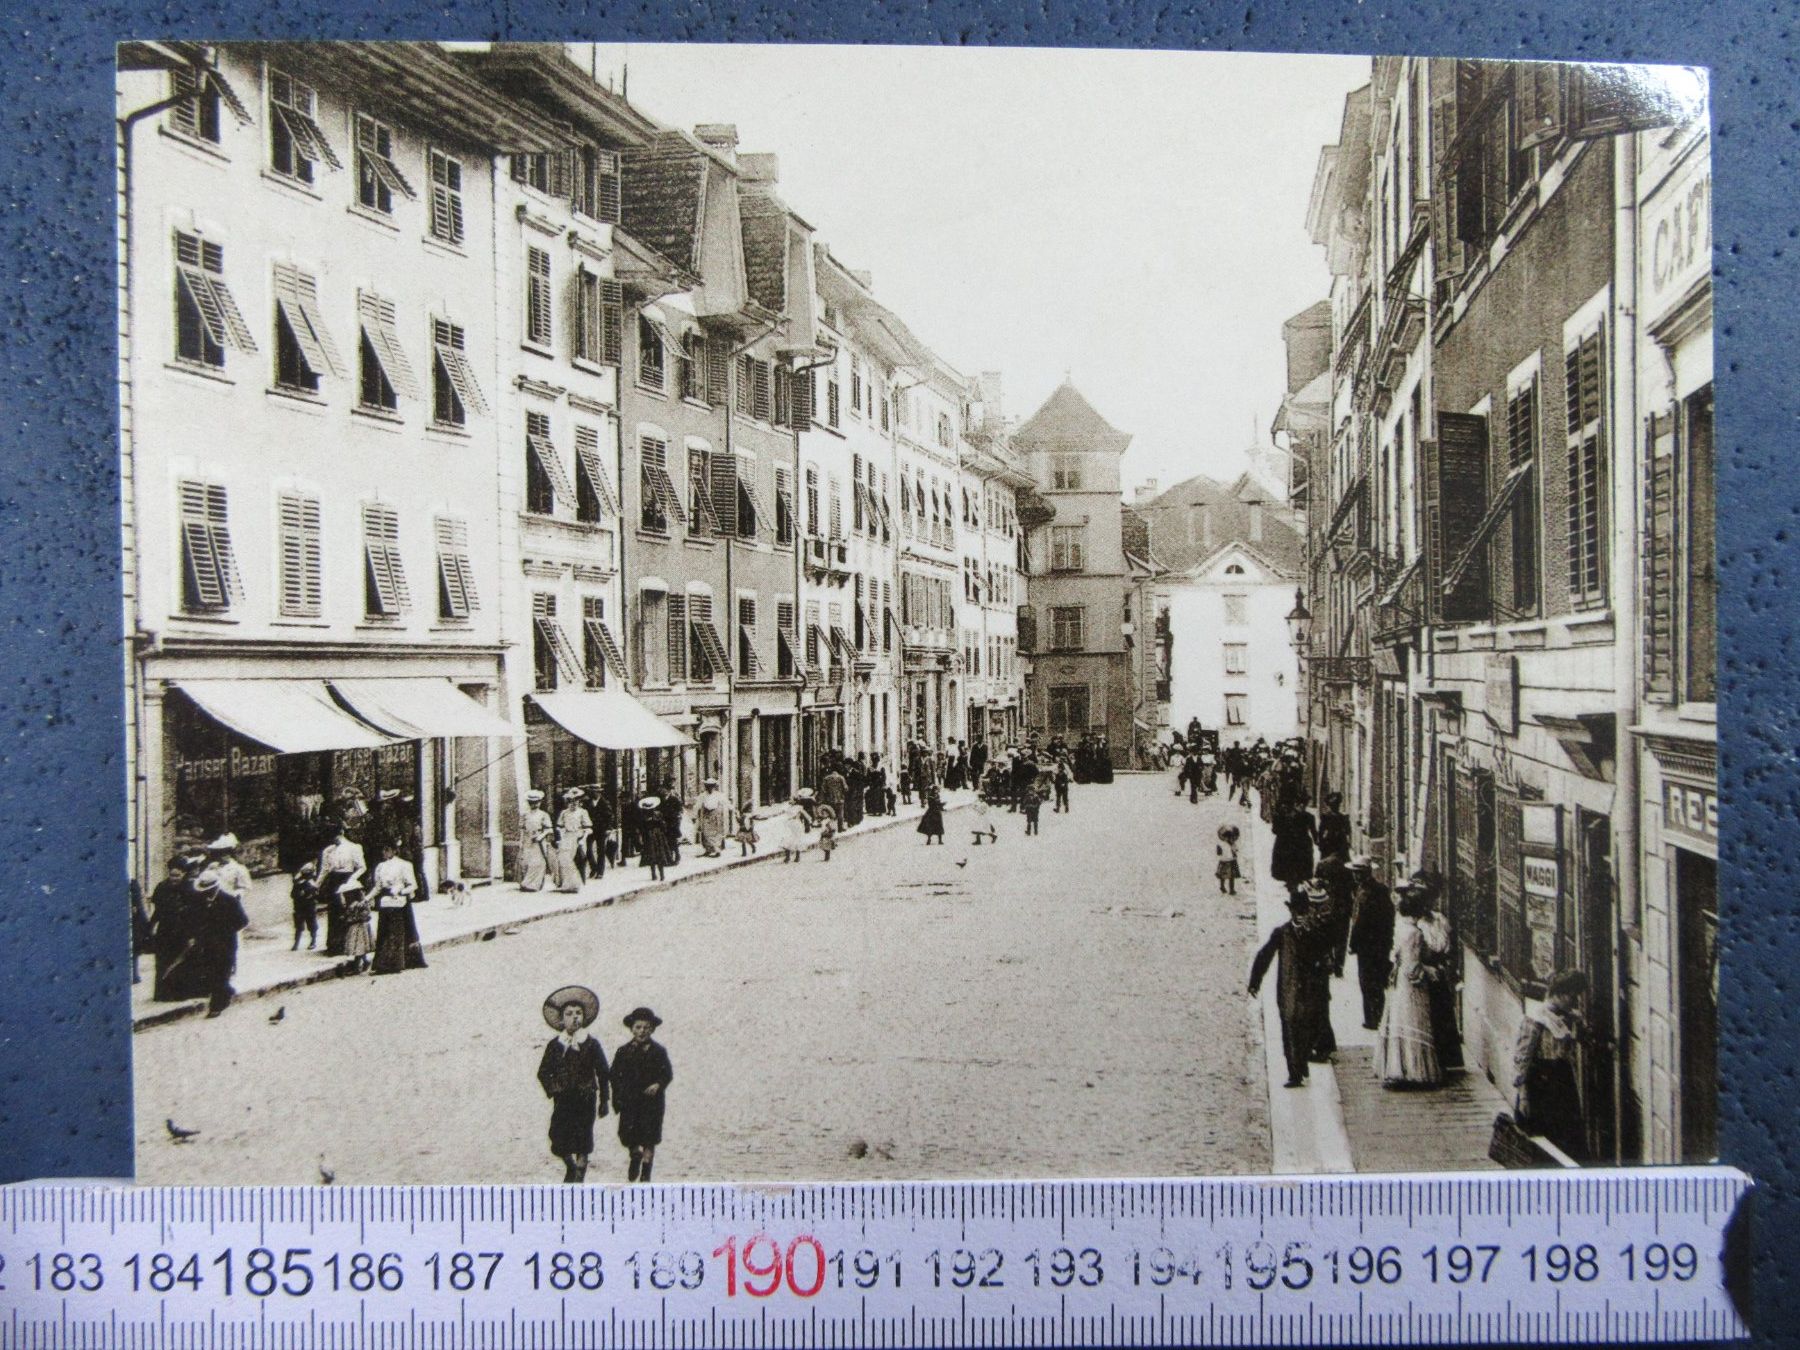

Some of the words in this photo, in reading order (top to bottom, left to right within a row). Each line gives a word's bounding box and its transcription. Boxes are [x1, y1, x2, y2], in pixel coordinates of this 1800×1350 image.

[1526, 863, 1556, 889] MAGGI
[26, 1252, 105, 1292] 183
[124, 1252, 204, 1293] 184
[212, 1247, 314, 1298] 185
[323, 1252, 404, 1292] 186
[424, 1251, 505, 1292] 187
[524, 1251, 605, 1291] 188
[624, 1250, 705, 1290] 189
[712, 1235, 826, 1298] 190
[828, 1249, 903, 1289] 191
[924, 1249, 1005, 1289] 192
[1024, 1247, 1105, 1288] 193
[1124, 1247, 1204, 1287] 194
[1215, 1240, 1314, 1291] 195
[1322, 1245, 1403, 1285] 196
[1421, 1244, 1502, 1284] 197
[1520, 1243, 1600, 1283] 198
[1619, 1242, 1698, 1282] 199
